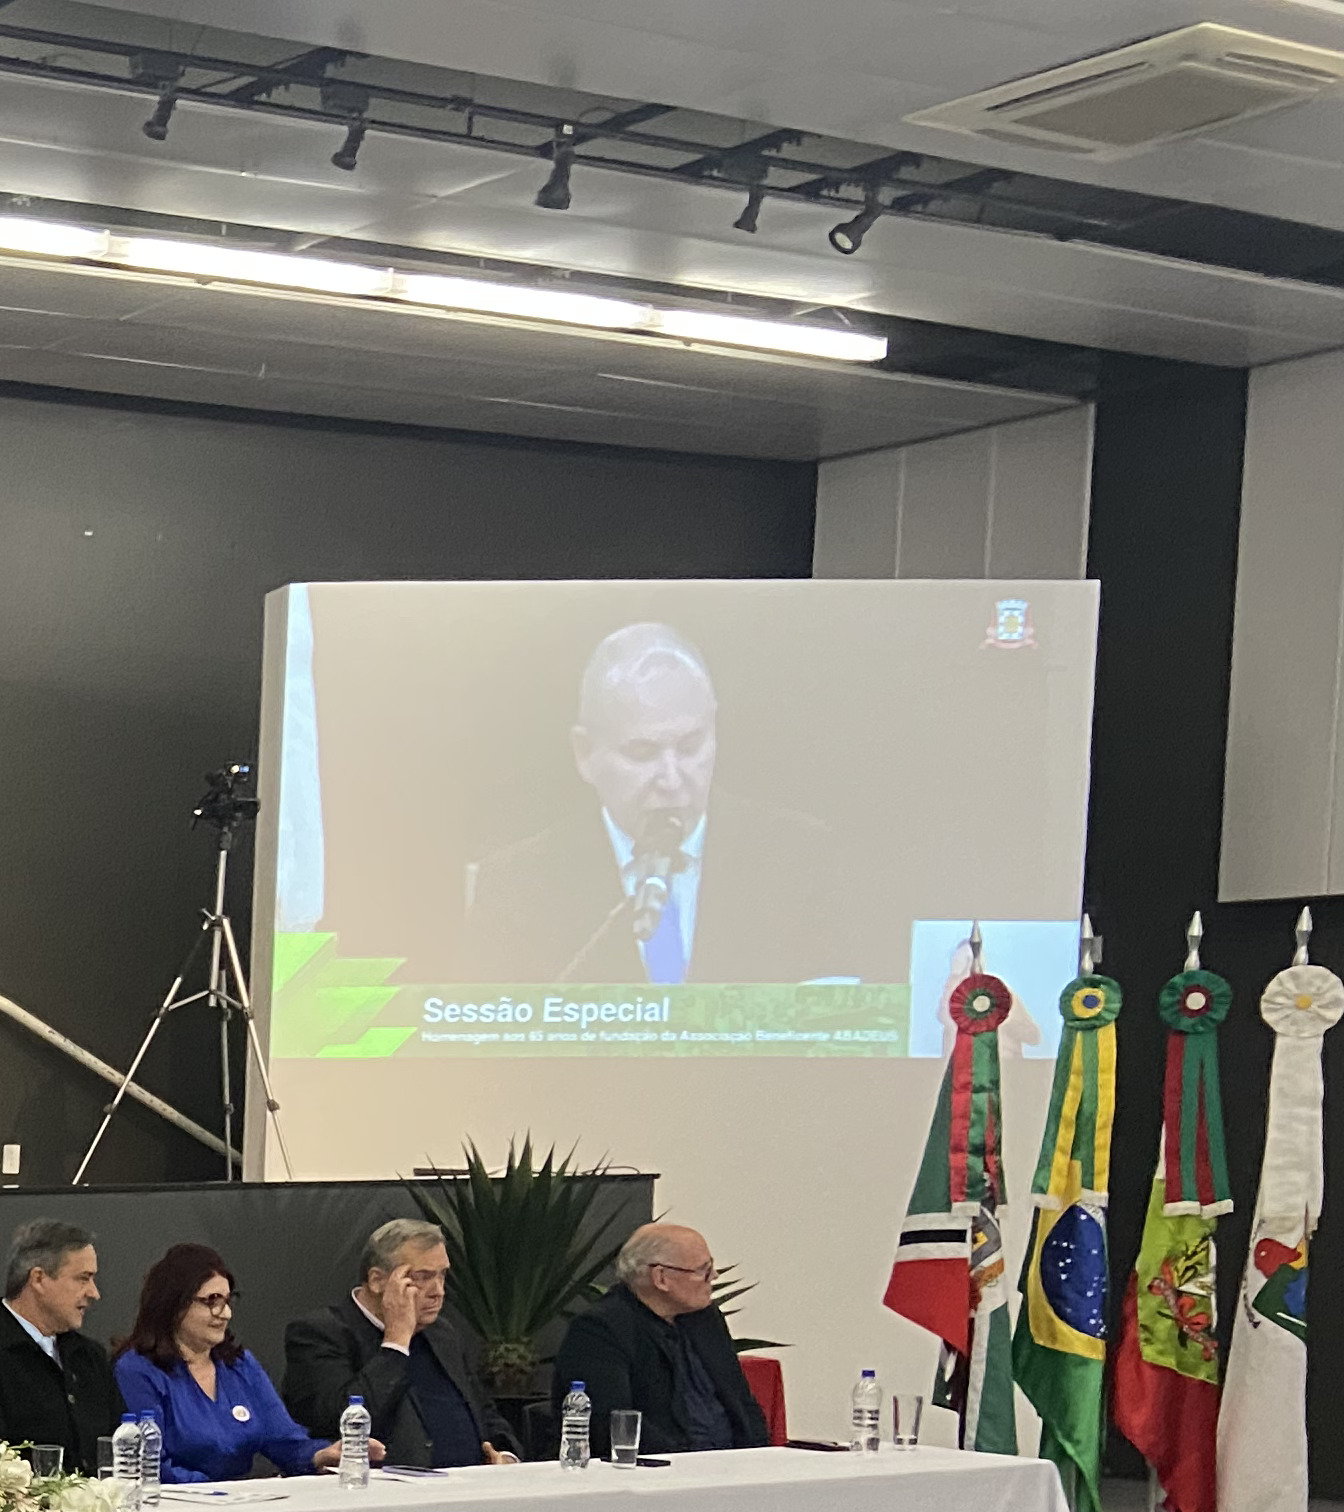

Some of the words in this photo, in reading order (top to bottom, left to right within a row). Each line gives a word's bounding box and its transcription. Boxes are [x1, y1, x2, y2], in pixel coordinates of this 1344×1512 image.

[423, 996, 533, 1023] Sessão
[542, 996, 670, 1029] Especial
[580, 1030, 597, 1042] de
